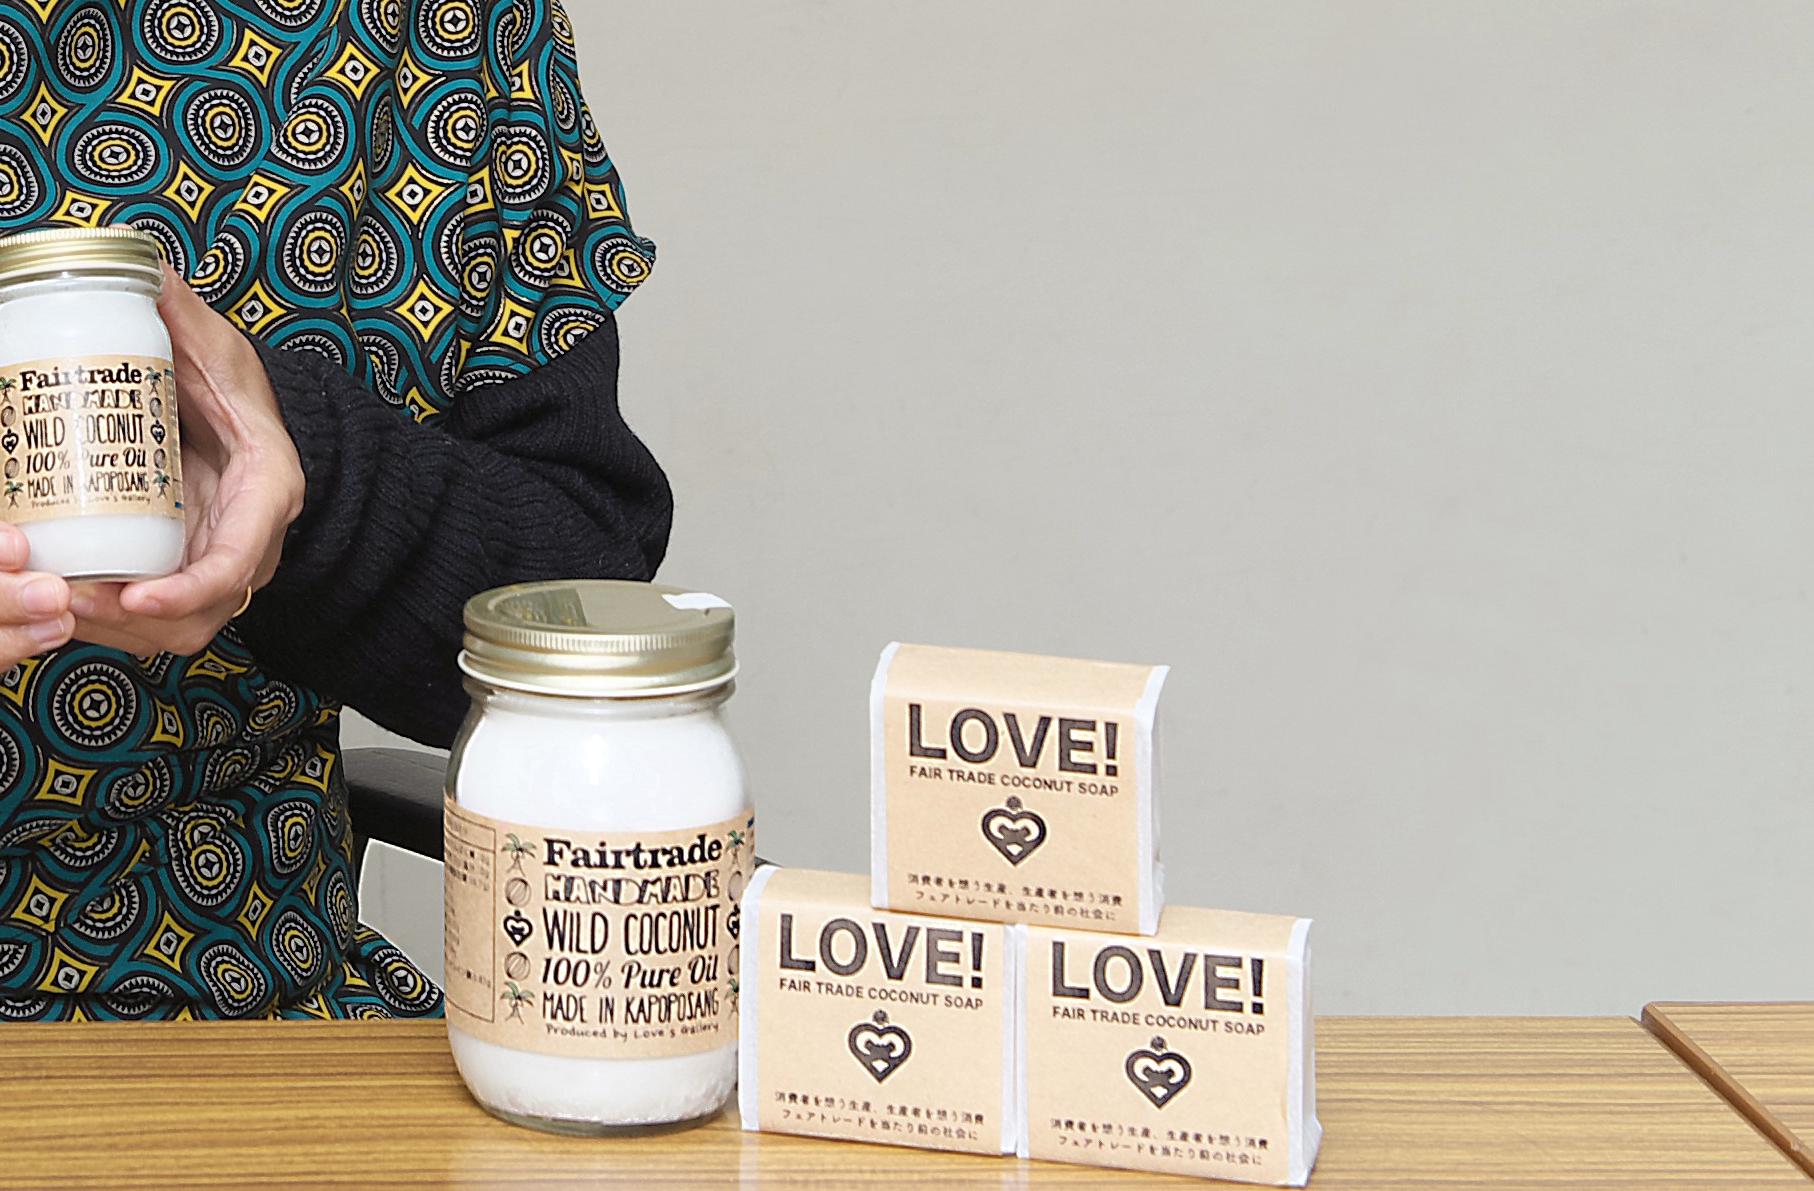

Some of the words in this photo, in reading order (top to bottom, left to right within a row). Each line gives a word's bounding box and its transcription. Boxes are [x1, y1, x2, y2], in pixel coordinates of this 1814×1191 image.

[20, 363, 142, 391] Fairtrade
[23, 416, 65, 449] WILD
[26, 450, 70, 474] 100%
[123, 447, 147, 468] Oil
[27, 475, 56, 498] MADE
[63, 475, 74, 495] IN
[908, 703, 1119, 778] LOVE!
[909, 765, 943, 780] FAIR
[948, 769, 996, 785] TRADE
[1001, 774, 1073, 793] COCONUT
[1079, 783, 1119, 797] SOAP
[543, 834, 723, 869] Fairtrade
[545, 869, 719, 906] HANDMADE
[542, 906, 608, 955] WILD
[624, 904, 720, 955] COCONUT
[779, 913, 984, 989] LOVE!
[542, 957, 612, 990] 100%
[621, 961, 682, 990] Pure
[688, 955, 719, 985] Oil
[1052, 941, 1265, 1015] LOVE!
[542, 991, 586, 1024] MADE
[599, 996, 615, 1024] IN
[624, 987, 719, 1025] KAPOPOSANG
[779, 978, 811, 993] FAIR
[816, 982, 863, 998] TRADE
[868, 988, 939, 1006] COCONUT
[944, 996, 983, 1010] SOAP
[546, 1023, 607, 1039] Produced
[613, 1029, 628, 1043] by
[681, 1022, 719, 1035] Gallery
[1052, 1006, 1086, 1020] FAIR
[1091, 1009, 1140, 1025] TRADE
[1145, 1014, 1219, 1032] COCONUT
[1224, 1021, 1265, 1036] SOAP
